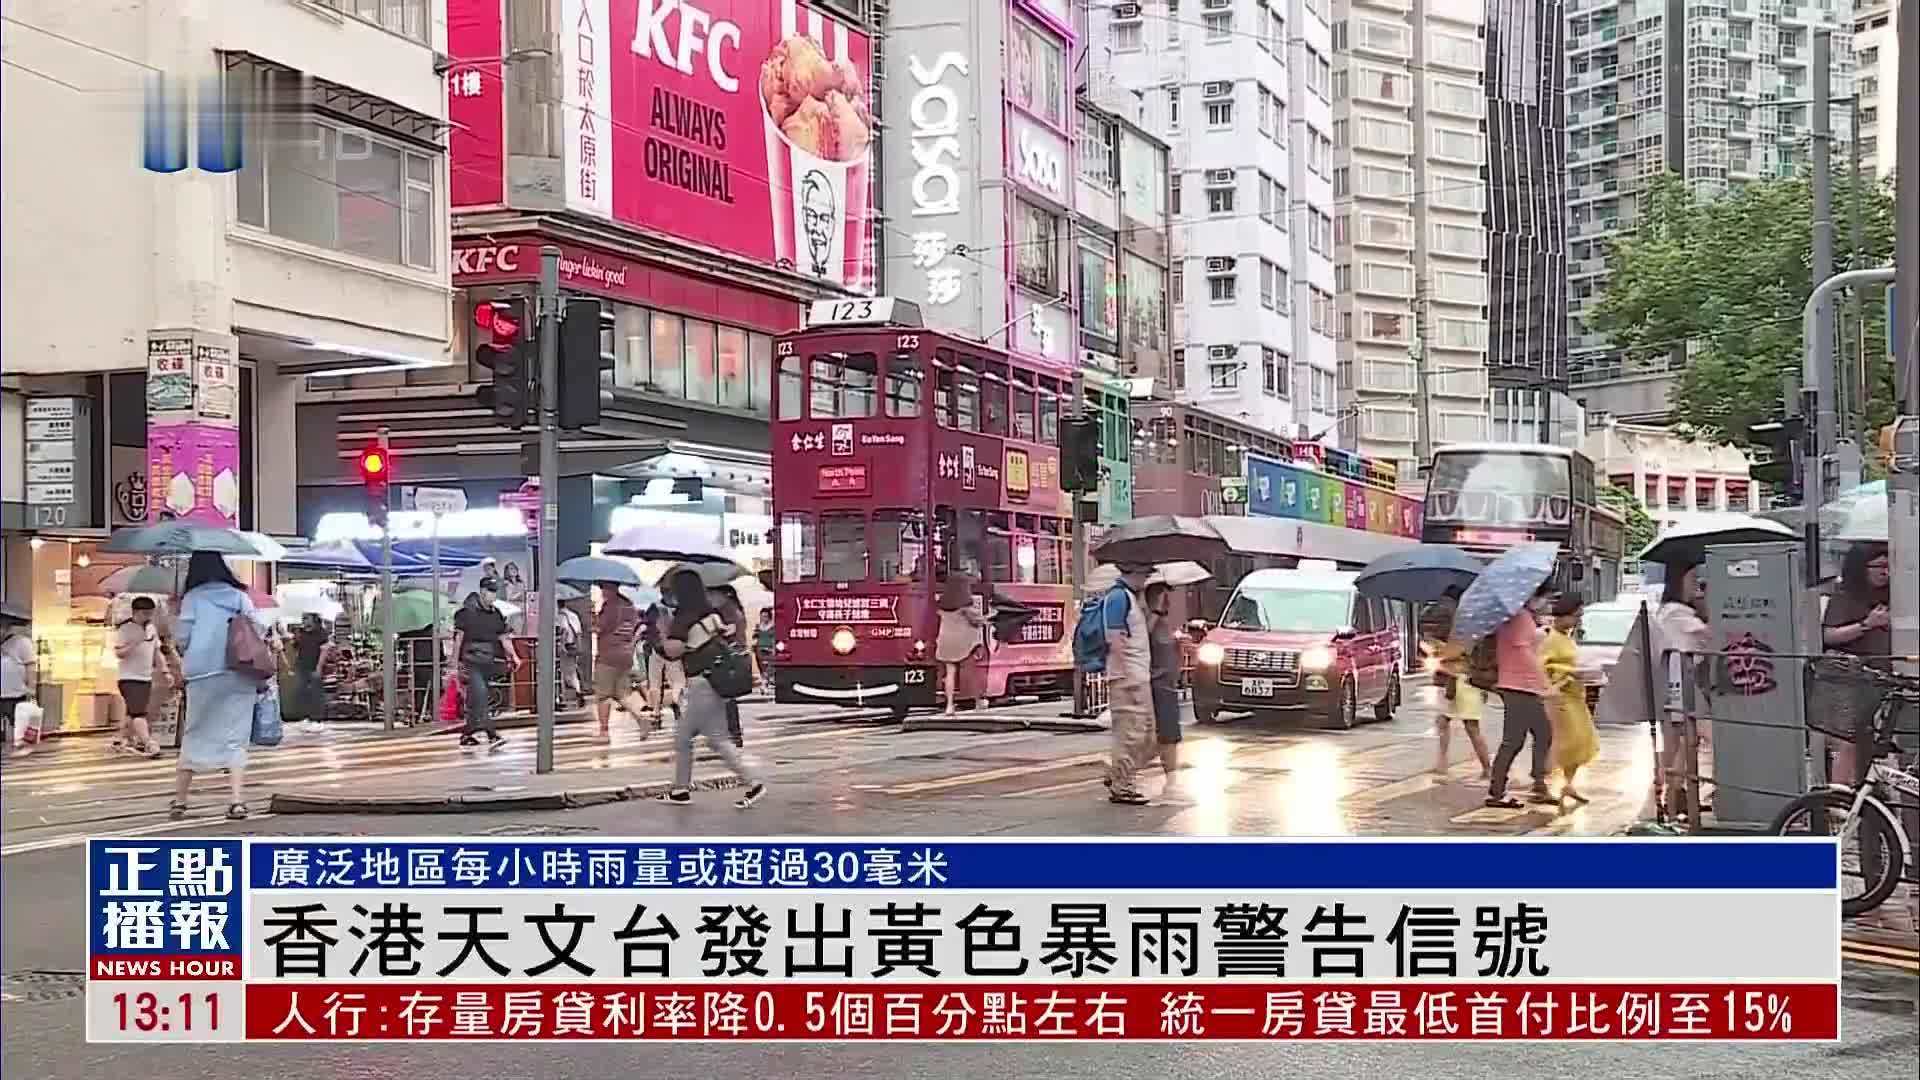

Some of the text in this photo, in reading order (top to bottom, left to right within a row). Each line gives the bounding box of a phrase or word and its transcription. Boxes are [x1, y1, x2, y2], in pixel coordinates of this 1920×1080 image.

[632, 0, 741, 93] KFC
[650, 86, 726, 153] ALWAYS
[643, 137, 734, 204] ORIGINAL
[452, 246, 519, 274] KFC
[912, 231, 961, 305] 莎莎
[831, 301, 873, 321] 123
[778, 341, 793, 355] 123
[897, 335, 919, 349] 123
[34, 506, 66, 526] 120
[904, 670, 925, 683] 123
